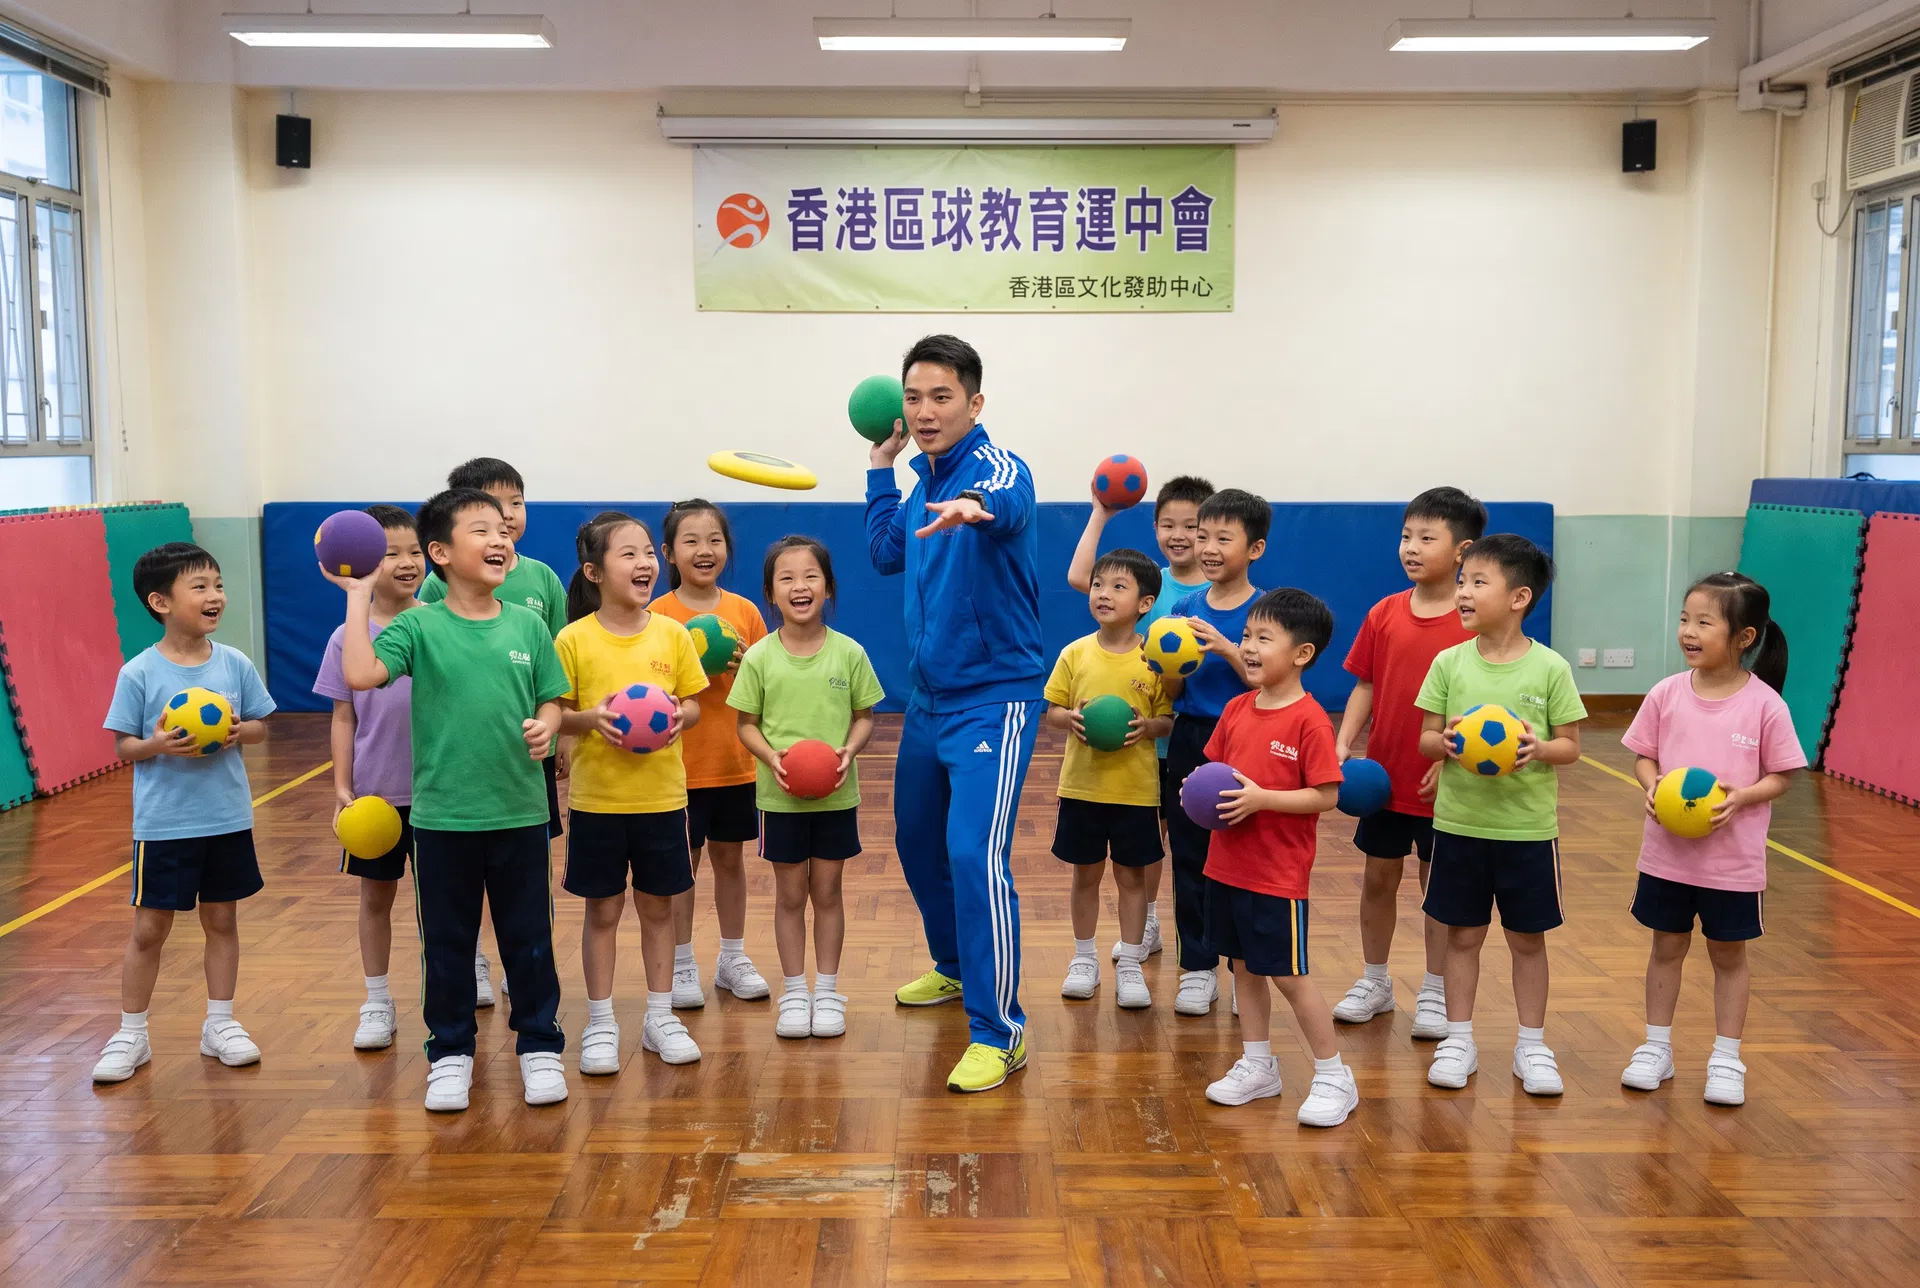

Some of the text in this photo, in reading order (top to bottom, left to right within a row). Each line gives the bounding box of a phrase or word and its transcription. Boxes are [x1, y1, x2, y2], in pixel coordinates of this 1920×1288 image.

[1009, 275, 1214, 299] 香港區文化發助中心
